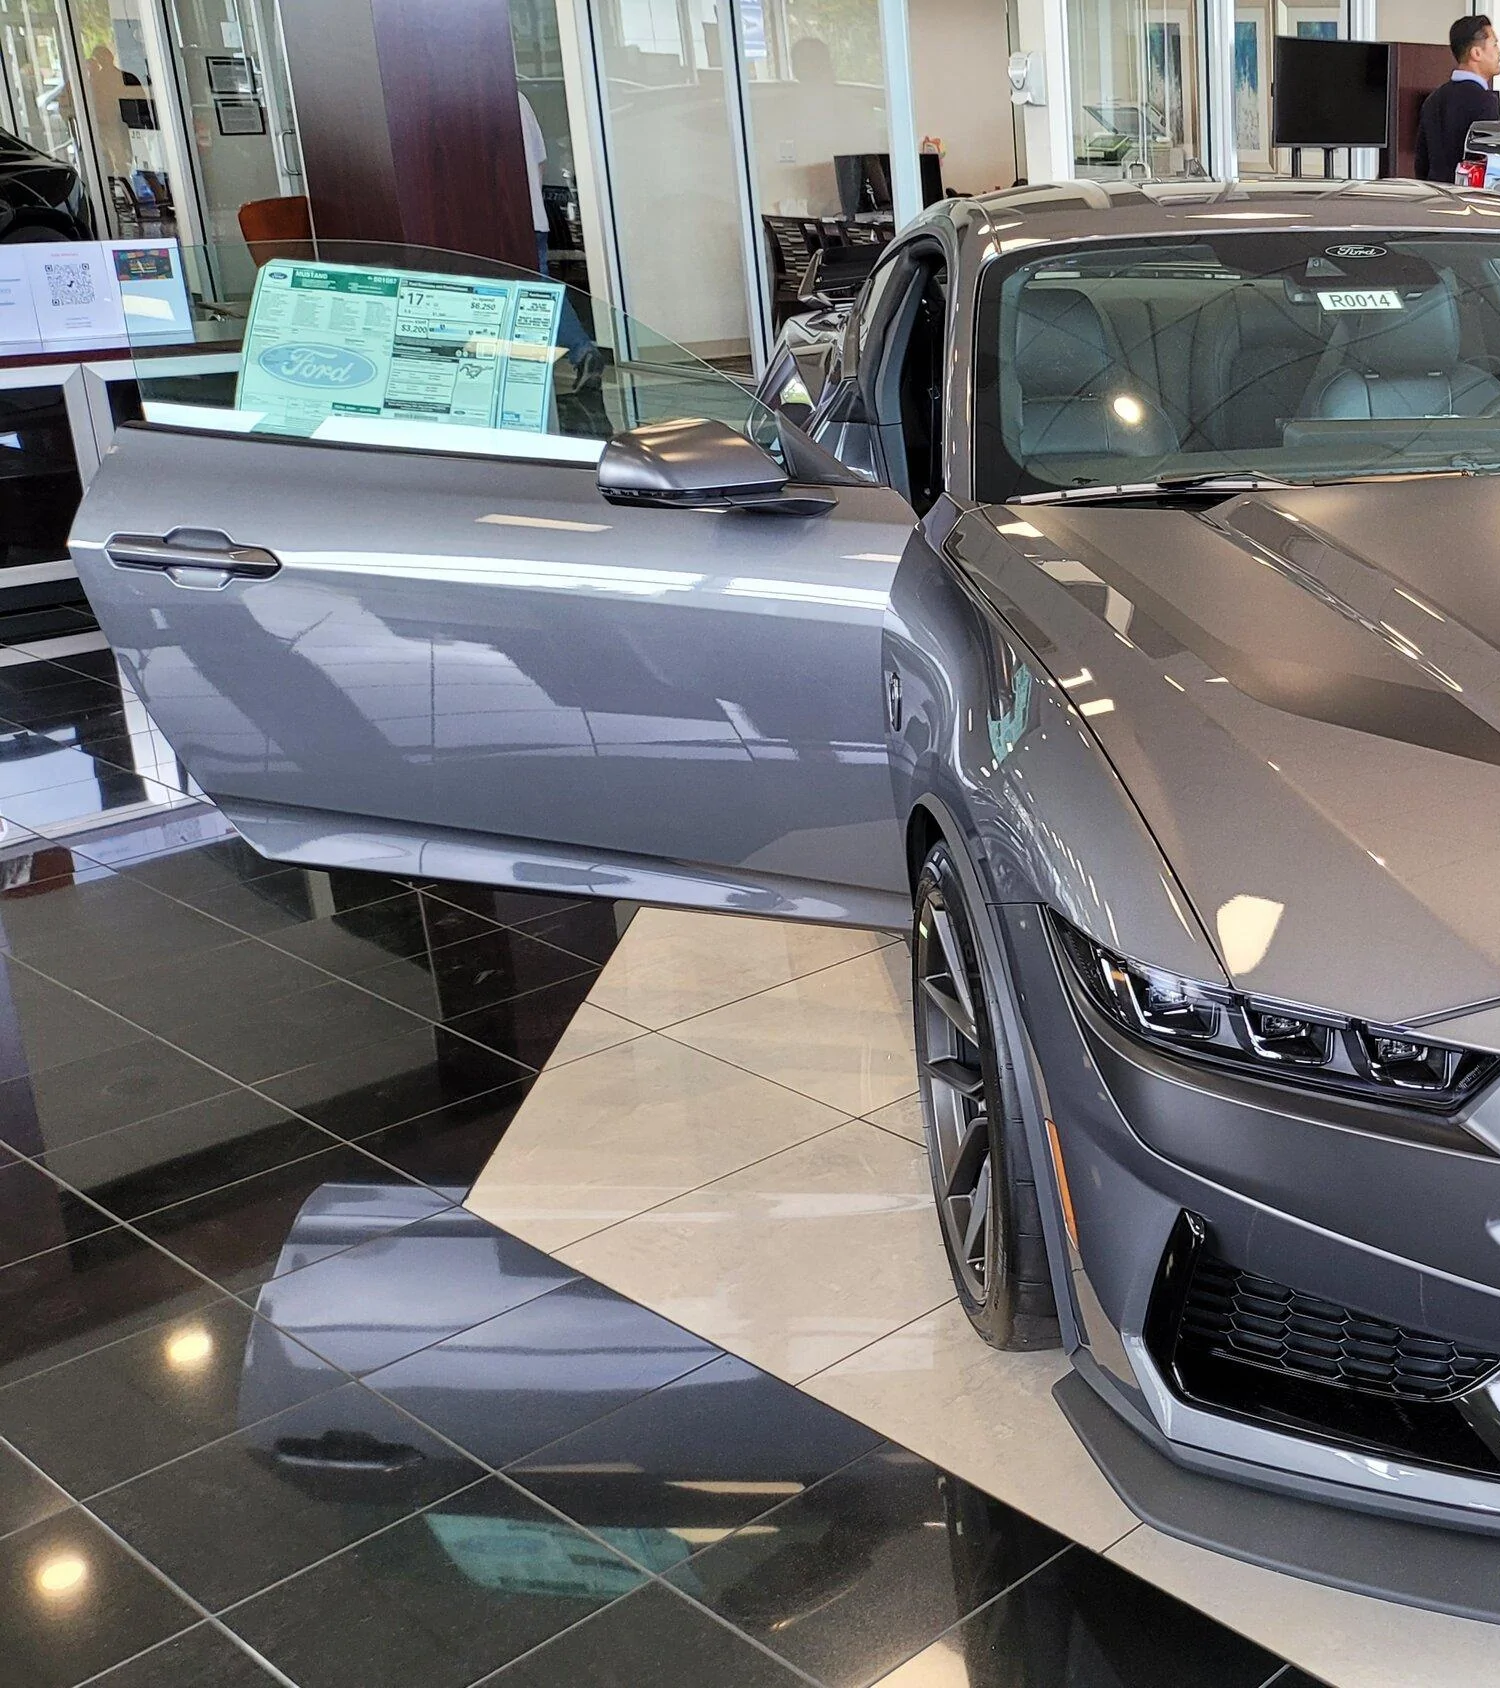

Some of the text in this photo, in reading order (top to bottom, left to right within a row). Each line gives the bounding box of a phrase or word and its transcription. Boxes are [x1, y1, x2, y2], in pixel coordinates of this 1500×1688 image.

[1336, 245, 1377, 256] Ford
[407, 292, 424, 306] 17
[1328, 294, 1392, 308] R0014
[280, 347, 354, 382] Ford
